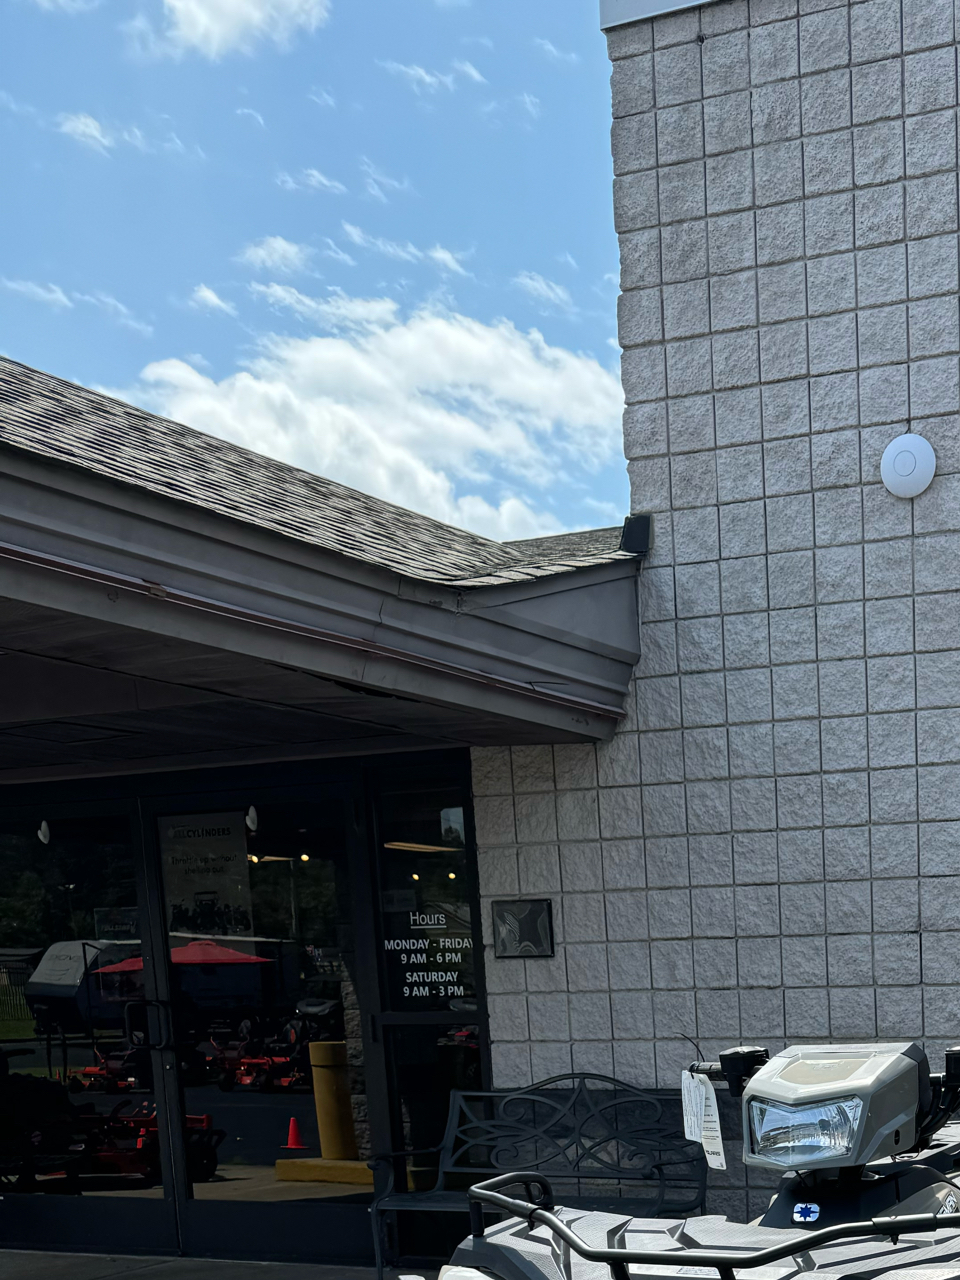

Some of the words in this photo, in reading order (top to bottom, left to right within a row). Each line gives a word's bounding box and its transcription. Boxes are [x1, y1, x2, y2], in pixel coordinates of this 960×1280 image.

[410, 911, 447, 926] Hours
[384, 939, 430, 951] MONDAY
[400, 954, 407, 964] 9
[410, 953, 427, 964] AM
[436, 953, 443, 963] 6
[445, 952, 462, 963] PM
[406, 971, 459, 983] SATURDAY
[403, 986, 410, 997] 9
[412, 986, 430, 997] AM
[439, 985, 445, 996] 3
[447, 985, 464, 996] PM
